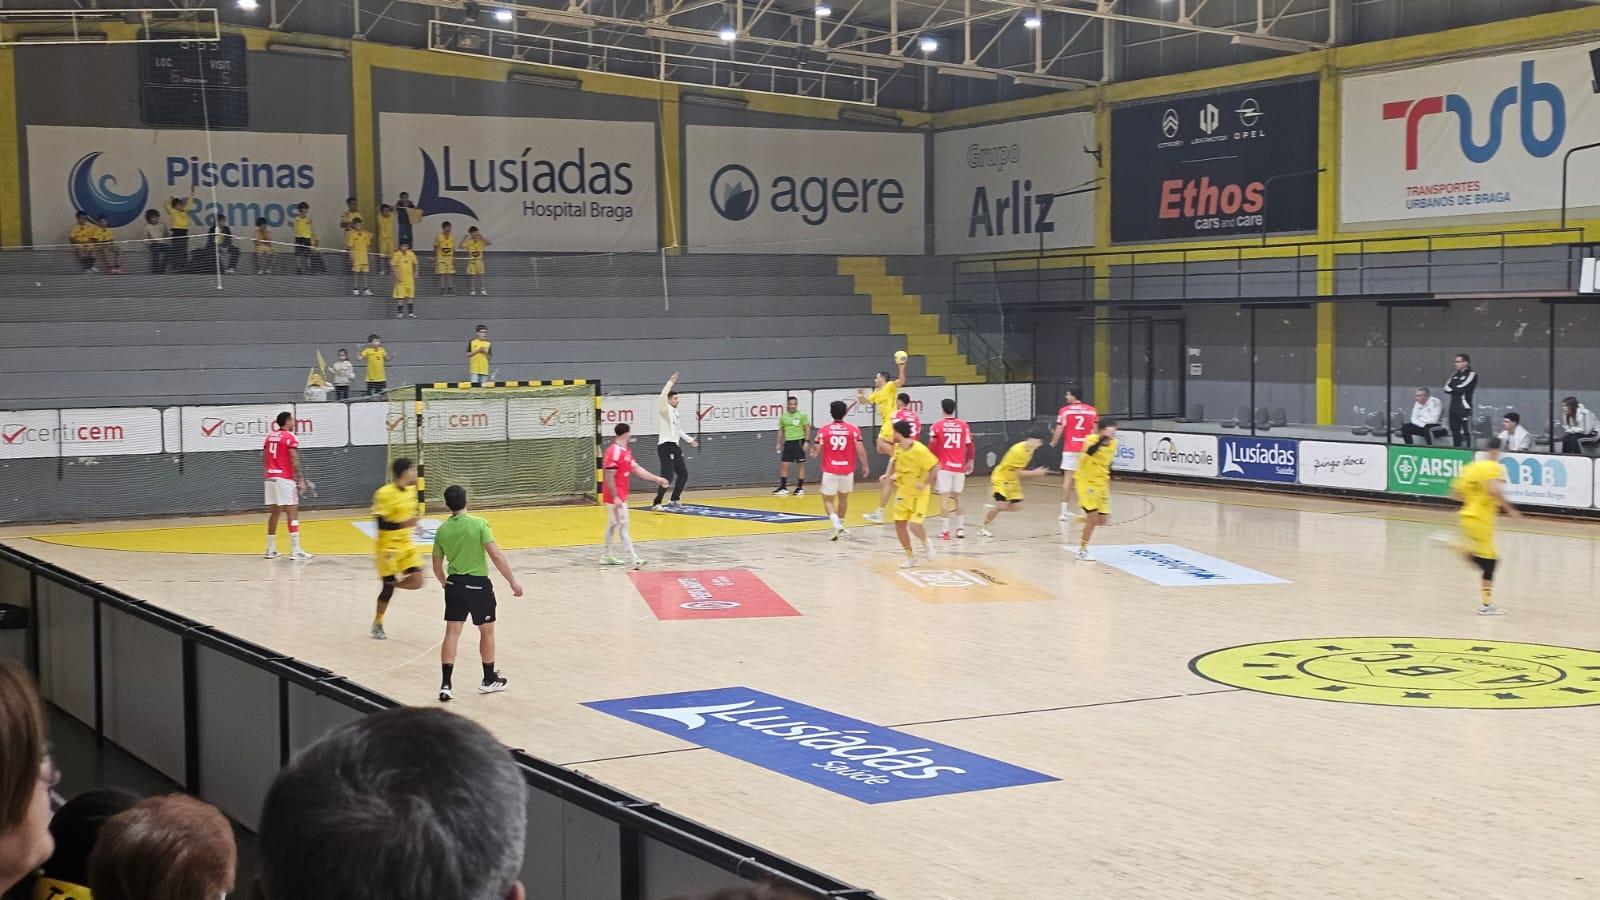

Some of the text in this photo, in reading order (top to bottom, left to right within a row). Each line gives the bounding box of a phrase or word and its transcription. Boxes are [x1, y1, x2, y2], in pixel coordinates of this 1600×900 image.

[967, 143, 1020, 172] Grupo
[166, 156, 314, 189] Piscinas
[443, 146, 633, 195] Lusíadas
[1158, 176, 1265, 219] Ethos
[1406, 180, 1480, 197] TRANSPORTES
[523, 200, 633, 221] Hospital Braga
[770, 175, 904, 226] agere
[968, 179, 1055, 238] Arliz
[1406, 192, 1511, 209] URBANOS DE BRAGA
[1195, 217, 1220, 229] cars
[1236, 214, 1263, 226] care
[713, 401, 784, 418] certicem
[26, 422, 124, 442] certicem
[223, 415, 313, 434] certicm
[1074, 415, 1085, 430] 2
[269, 442, 278, 459] 4
[830, 436, 848, 451] 99
[943, 433, 961, 449] 24
[1232, 441, 1295, 465] Lusíadas
[712, 706, 966, 780] Lusíadas
[811, 759, 890, 786] Saúde
